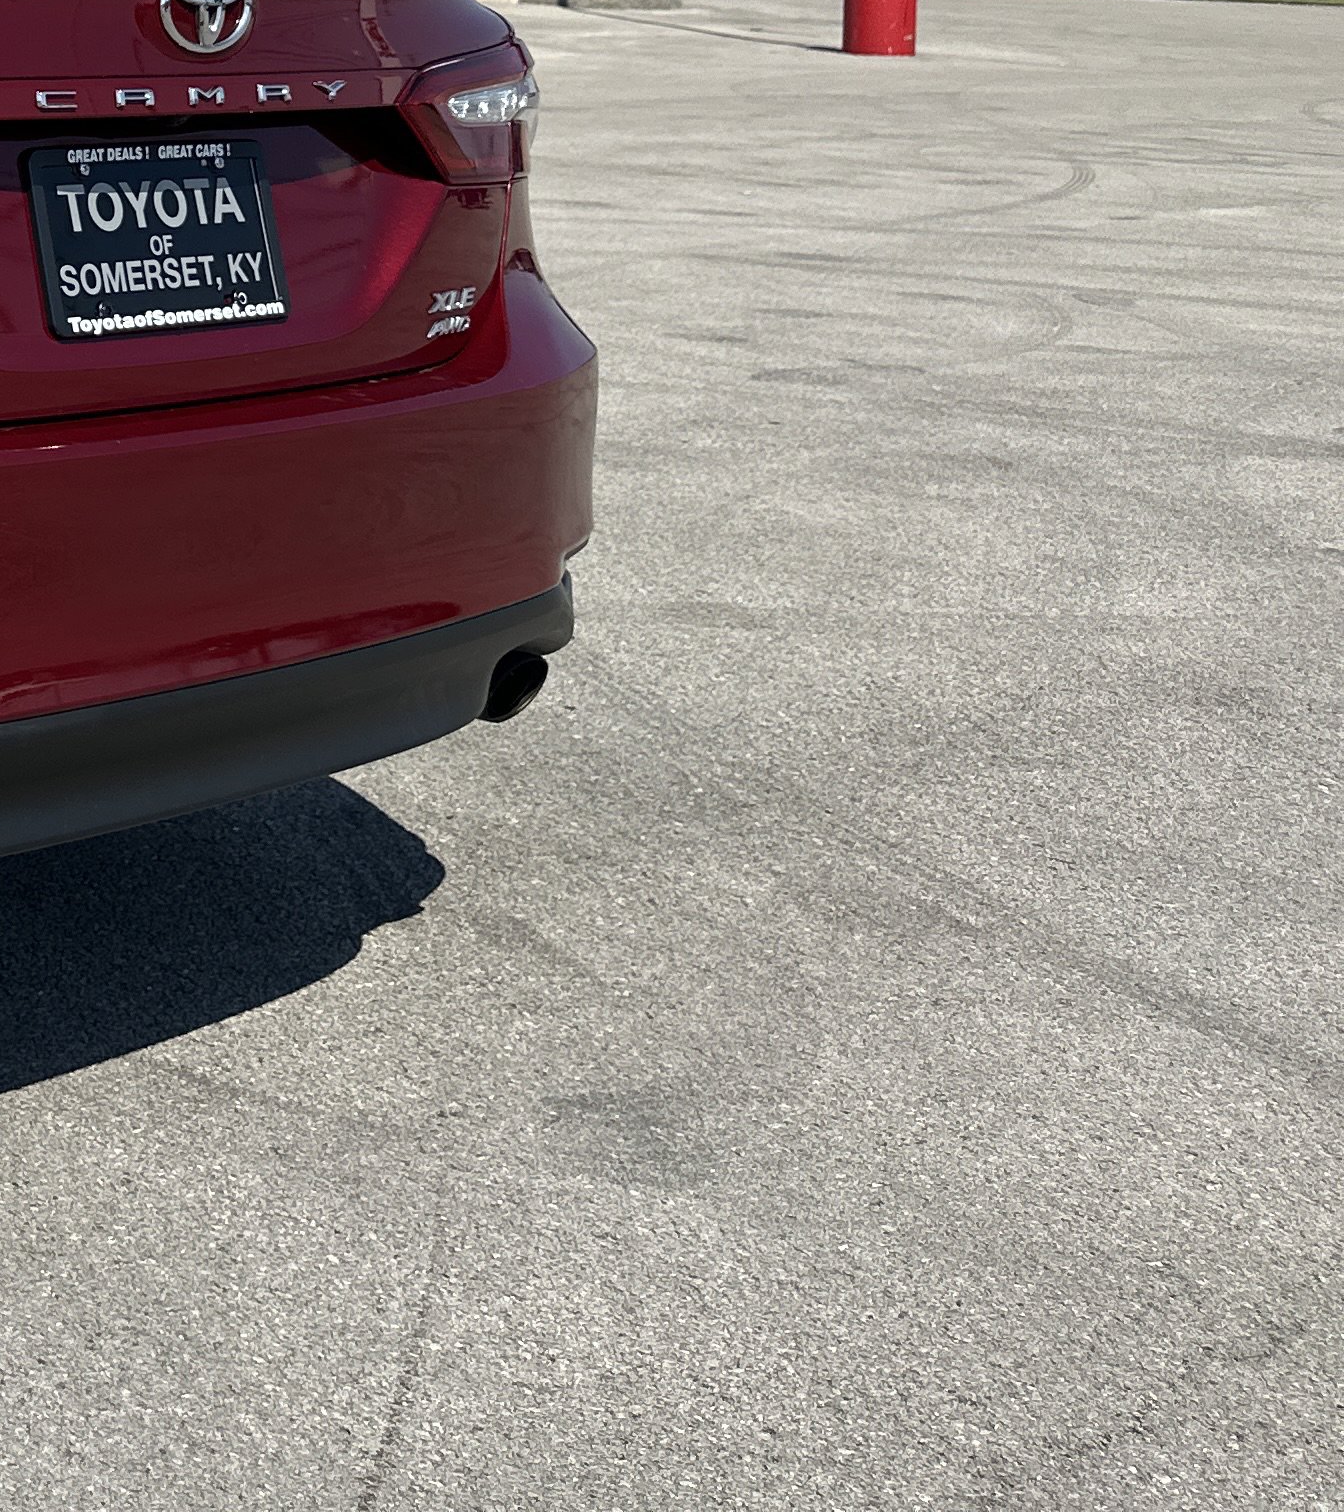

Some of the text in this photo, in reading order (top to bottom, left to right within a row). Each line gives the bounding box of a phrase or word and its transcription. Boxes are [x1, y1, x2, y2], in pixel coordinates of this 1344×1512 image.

[35, 79, 348, 110] CAMRY
[67, 148, 105, 164] GREAT
[157, 144, 194, 159] GREAT
[56, 176, 246, 233] TOYOTA
[149, 234, 174, 256] OF
[60, 251, 262, 298] SOMERSET, KY
[427, 286, 477, 314] XLE
[67, 301, 285, 335] ToyotaofSomerset.com
